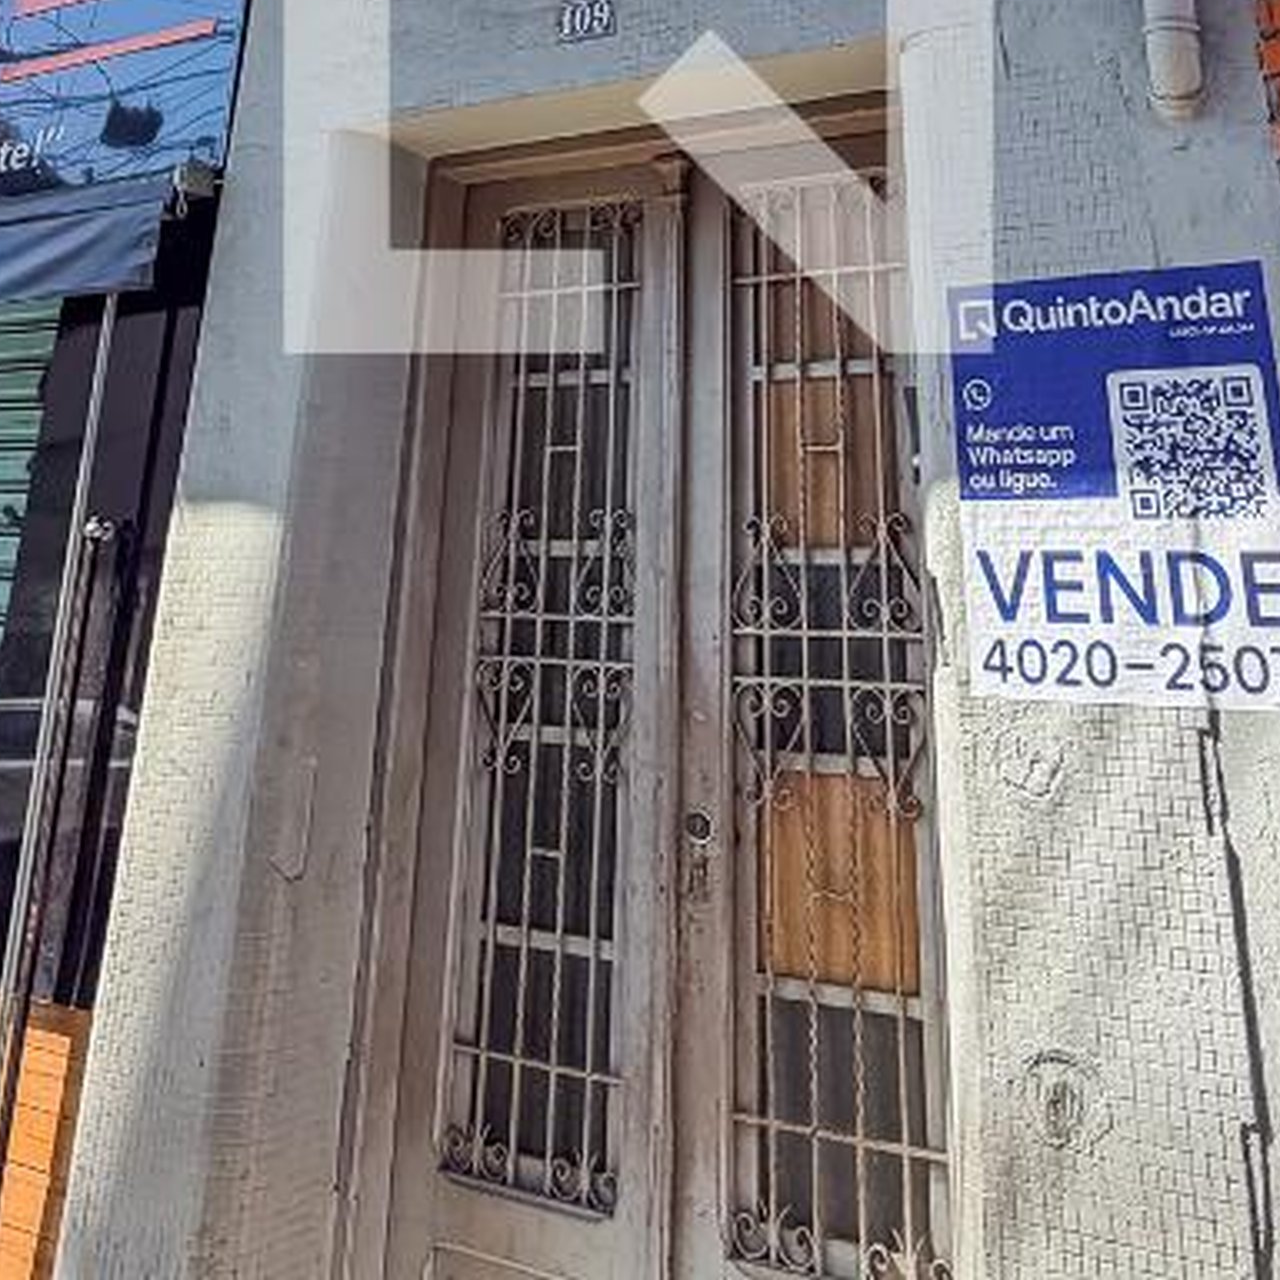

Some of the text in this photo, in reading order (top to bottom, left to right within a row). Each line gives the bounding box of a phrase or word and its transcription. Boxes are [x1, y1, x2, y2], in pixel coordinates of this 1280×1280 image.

[561, 0, 610, 37] 109
[1002, 287, 1252, 333] QuintoAndar
[1039, 425, 1074, 441] um
[970, 474, 996, 488] ou
